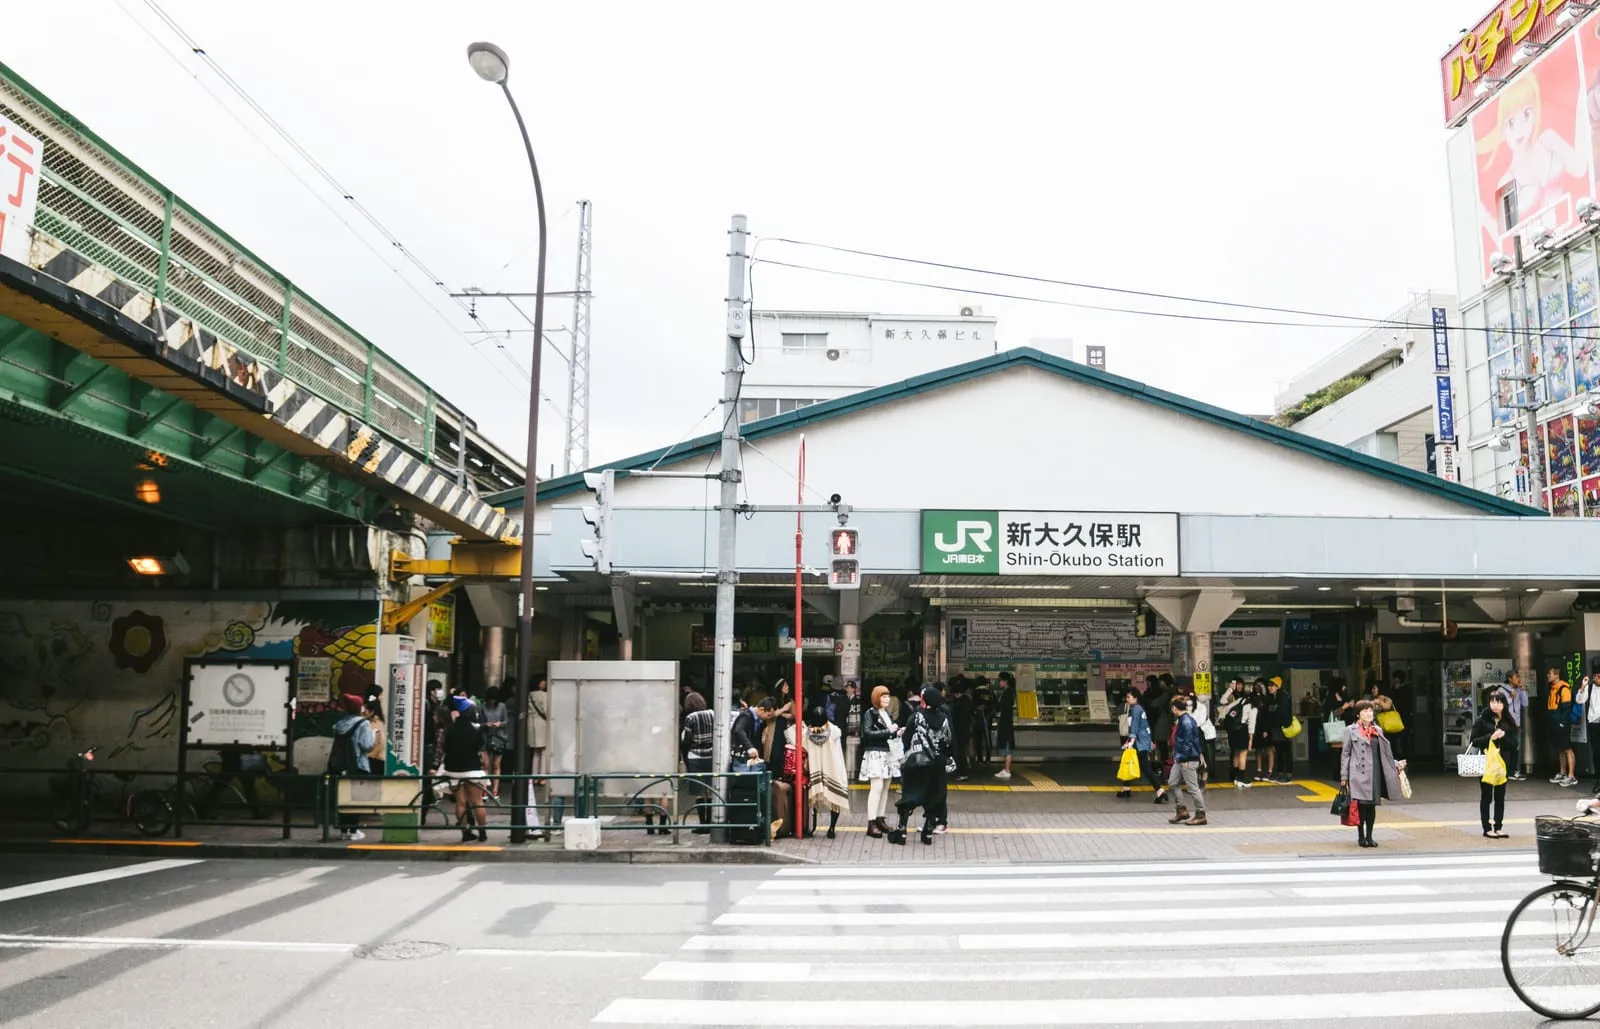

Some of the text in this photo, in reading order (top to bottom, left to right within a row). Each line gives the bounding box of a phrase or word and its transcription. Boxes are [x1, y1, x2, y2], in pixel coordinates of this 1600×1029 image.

[885, 329, 981, 340] 新大久保ビル
[934, 520, 992, 552] JR
[1007, 522, 1141, 548] 新大久保駅
[942, 554, 985, 564] JR東日本
[1107, 553, 1164, 568] Station
